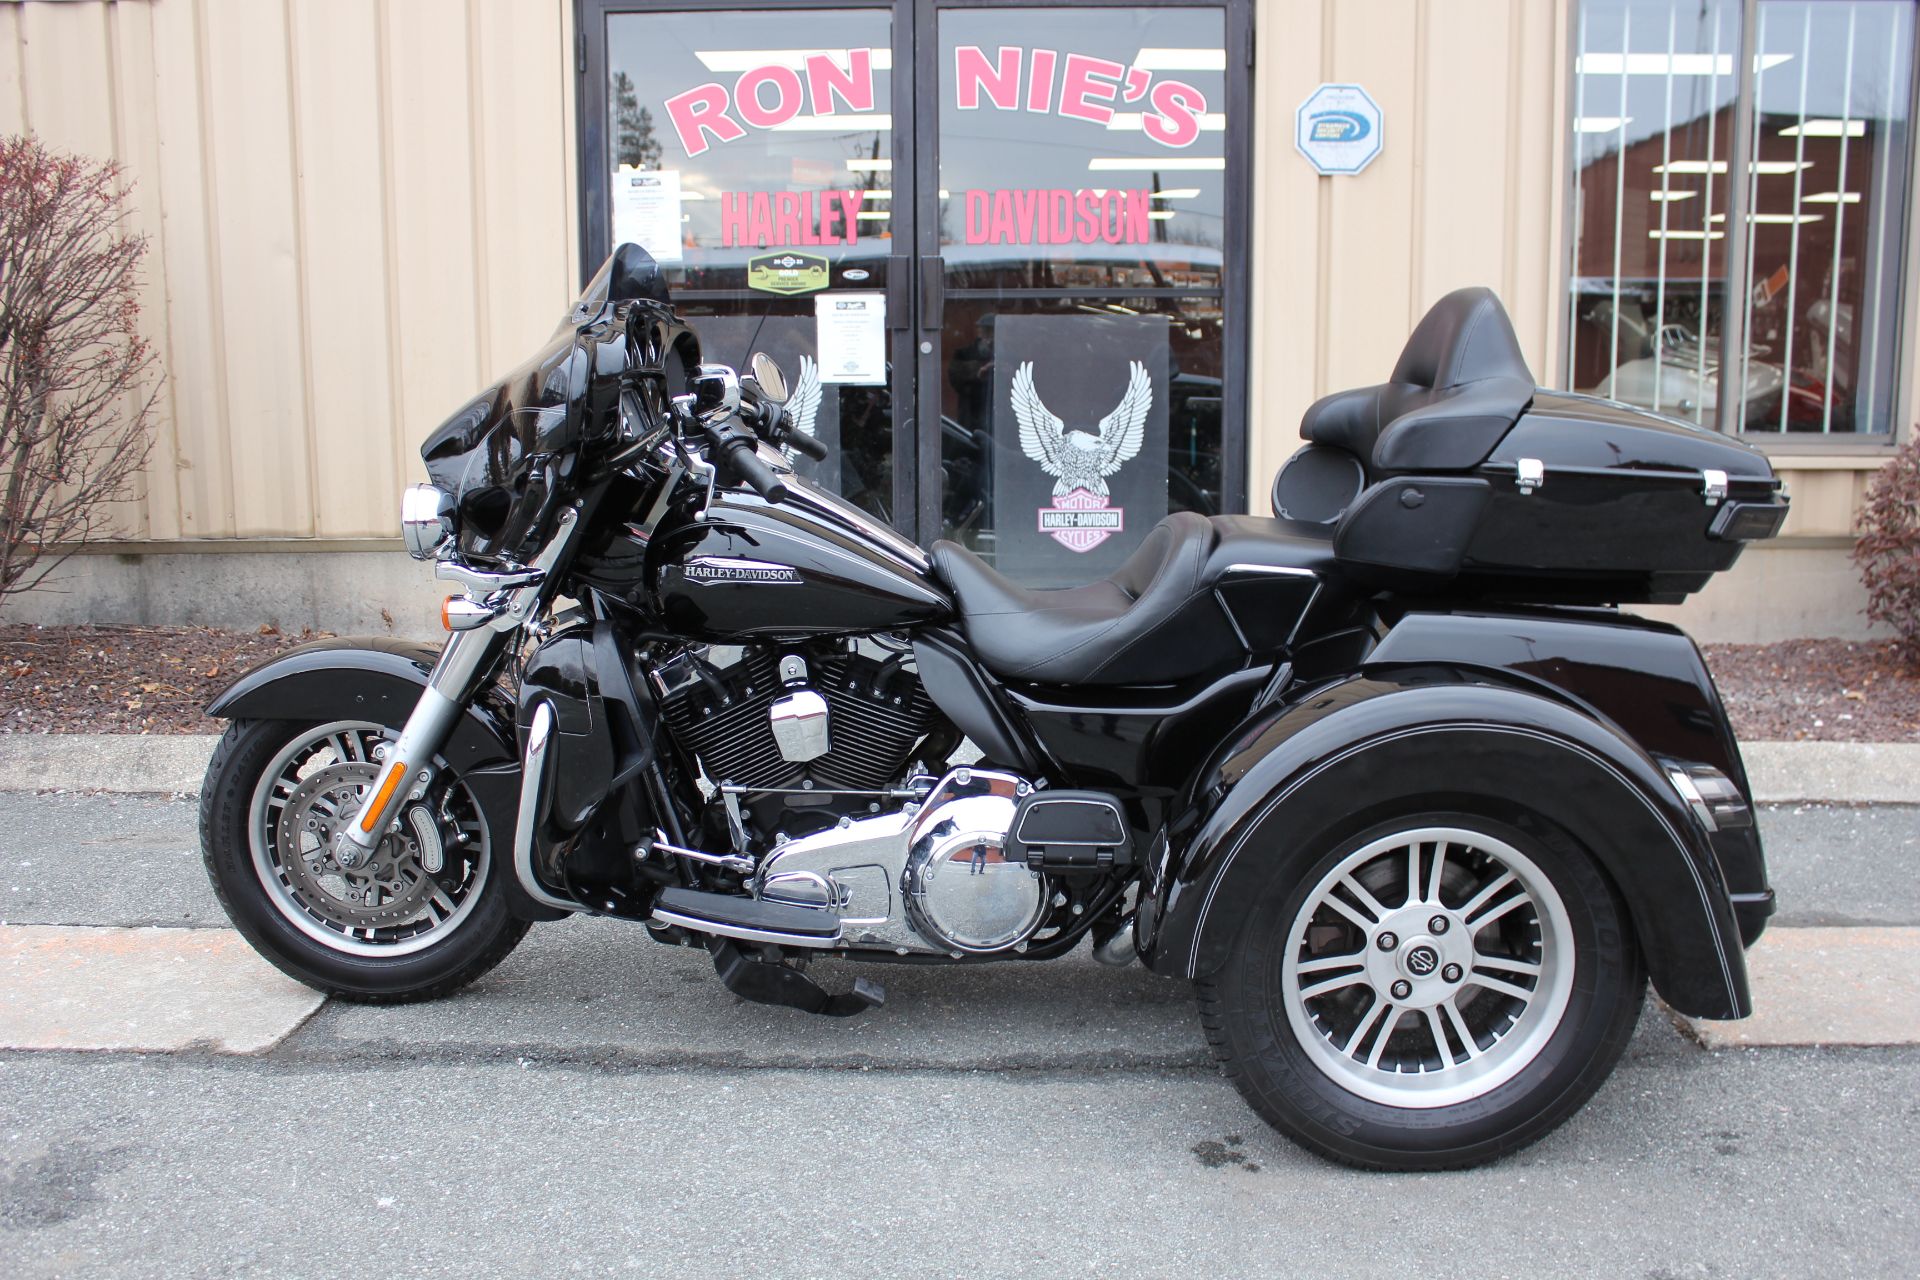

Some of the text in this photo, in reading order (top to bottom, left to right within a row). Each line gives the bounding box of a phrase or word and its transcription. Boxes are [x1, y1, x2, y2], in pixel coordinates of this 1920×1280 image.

[664, 45, 1207, 159] RON NIE'S
[721, 189, 865, 247] HARLEY
[966, 188, 1150, 246] DAVIDSON
[1061, 498, 1102, 509] MOTOR
[1044, 512, 1118, 527] HARLEY-DAVIDSON
[1061, 531, 1101, 545] CYCLES
[685, 566, 793, 580] HARLEY-DAVIDSON
